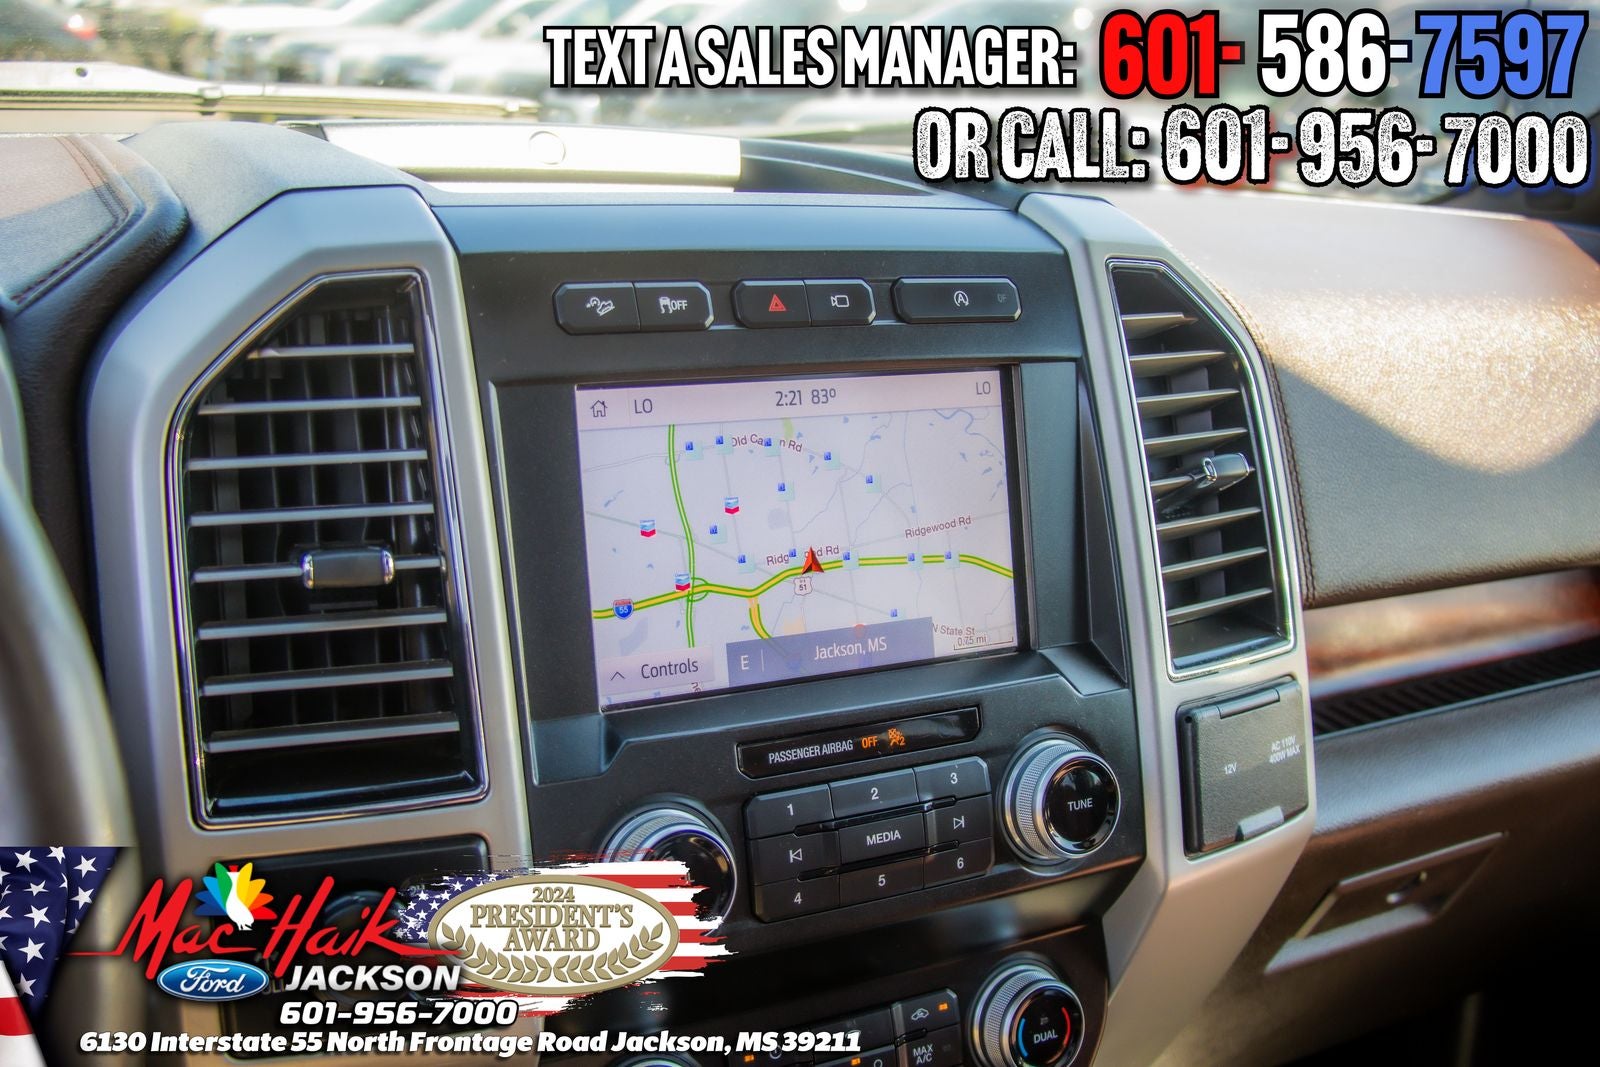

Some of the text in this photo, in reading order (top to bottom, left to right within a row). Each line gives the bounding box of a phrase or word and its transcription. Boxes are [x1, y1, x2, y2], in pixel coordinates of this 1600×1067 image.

[670, 300, 688, 311] OFF
[975, 380, 991, 396] LO
[775, 389, 803, 407] 2:21
[634, 398, 653, 414] LO
[787, 439, 803, 453] Rd
[904, 515, 972, 539] Ridgewood Rd
[825, 545, 840, 556] Rd
[940, 624, 963, 637] State
[965, 626, 976, 636] St
[976, 633, 987, 643] mi
[813, 636, 888, 661] Jackson, MS
[640, 657, 699, 680] Controls
[740, 655, 750, 671] E
[768, 735, 878, 765] PASSENGER AIRBAG OFF
[1224, 761, 1238, 775] 12V
[949, 772, 959, 784] 3
[870, 787, 880, 800] 2
[787, 803, 795, 816] 1
[1067, 797, 1093, 812] TUNE
[866, 829, 901, 846] MEDIA
[956, 857, 965, 870] 6
[877, 874, 886, 887] 5
[794, 892, 802, 905] 4
[1033, 1028, 1059, 1044] DUAL
[913, 1043, 934, 1057] MAX
[915, 1052, 933, 1066] A/C
